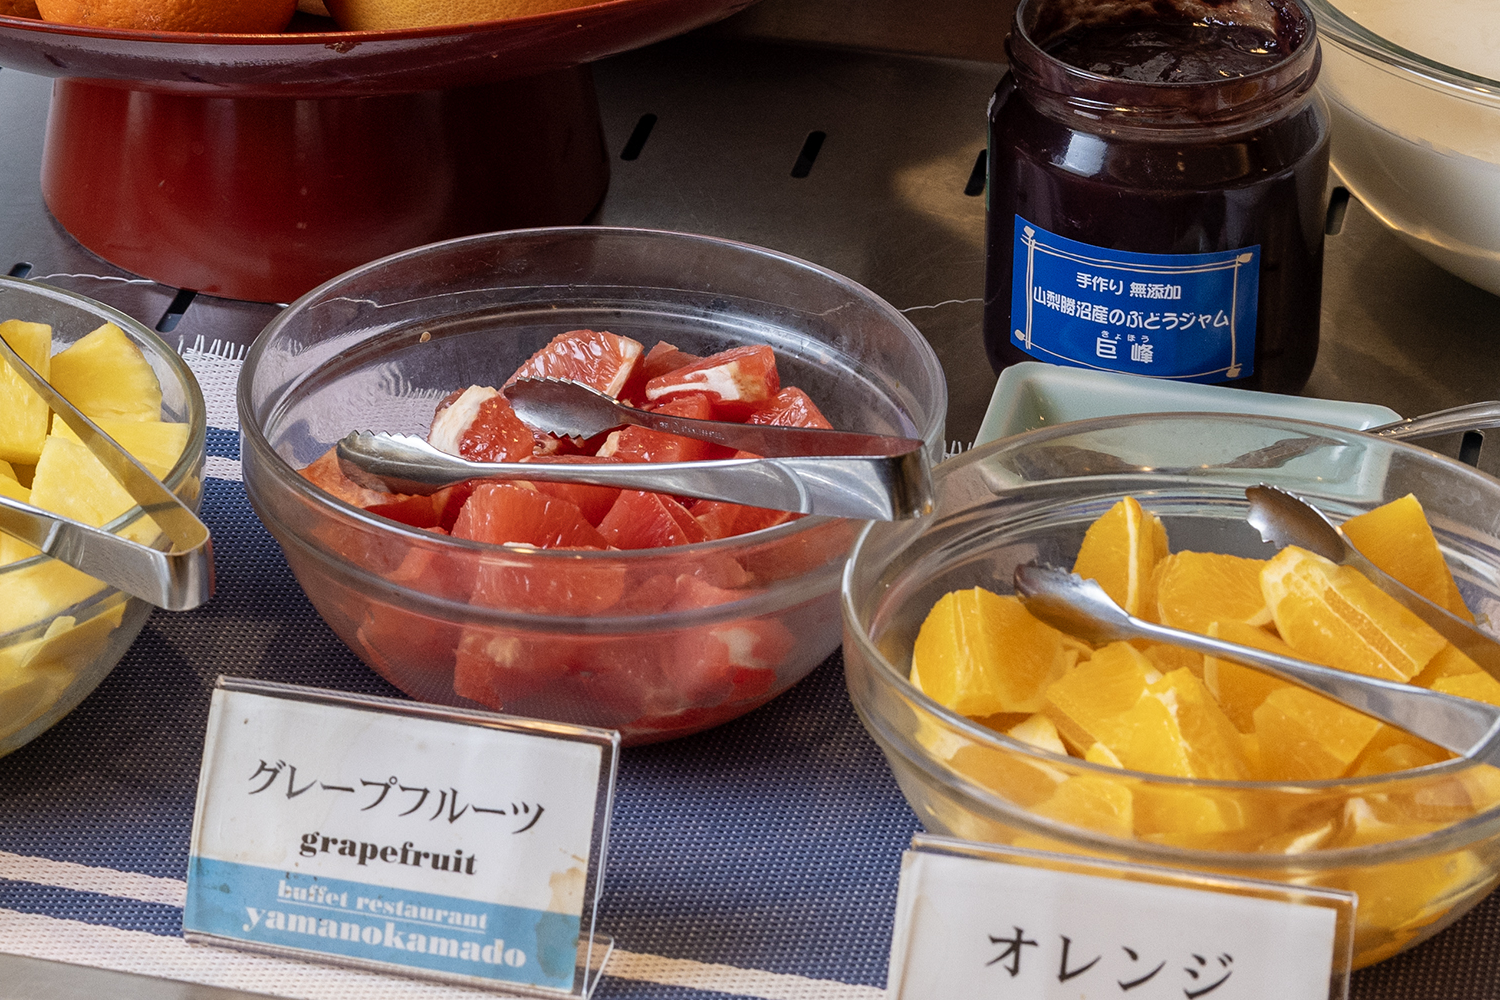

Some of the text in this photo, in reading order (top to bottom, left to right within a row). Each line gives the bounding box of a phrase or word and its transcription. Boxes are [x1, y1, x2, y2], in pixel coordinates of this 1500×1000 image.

[1033, 286, 1229, 331] 山梨勝沼産のぶどうジャム
[1076, 272, 1181, 300] 手作り 無添加
[1096, 336, 1153, 364] 巨峰
[1101, 330, 1150, 343] きょほう
[248, 758, 545, 835] グレープフルーツ
[299, 830, 478, 876] grapefruit
[277, 879, 487, 930] buffet restaurant
[242, 905, 527, 969] yamanokamado
[985, 925, 1234, 1000] オレンジ
